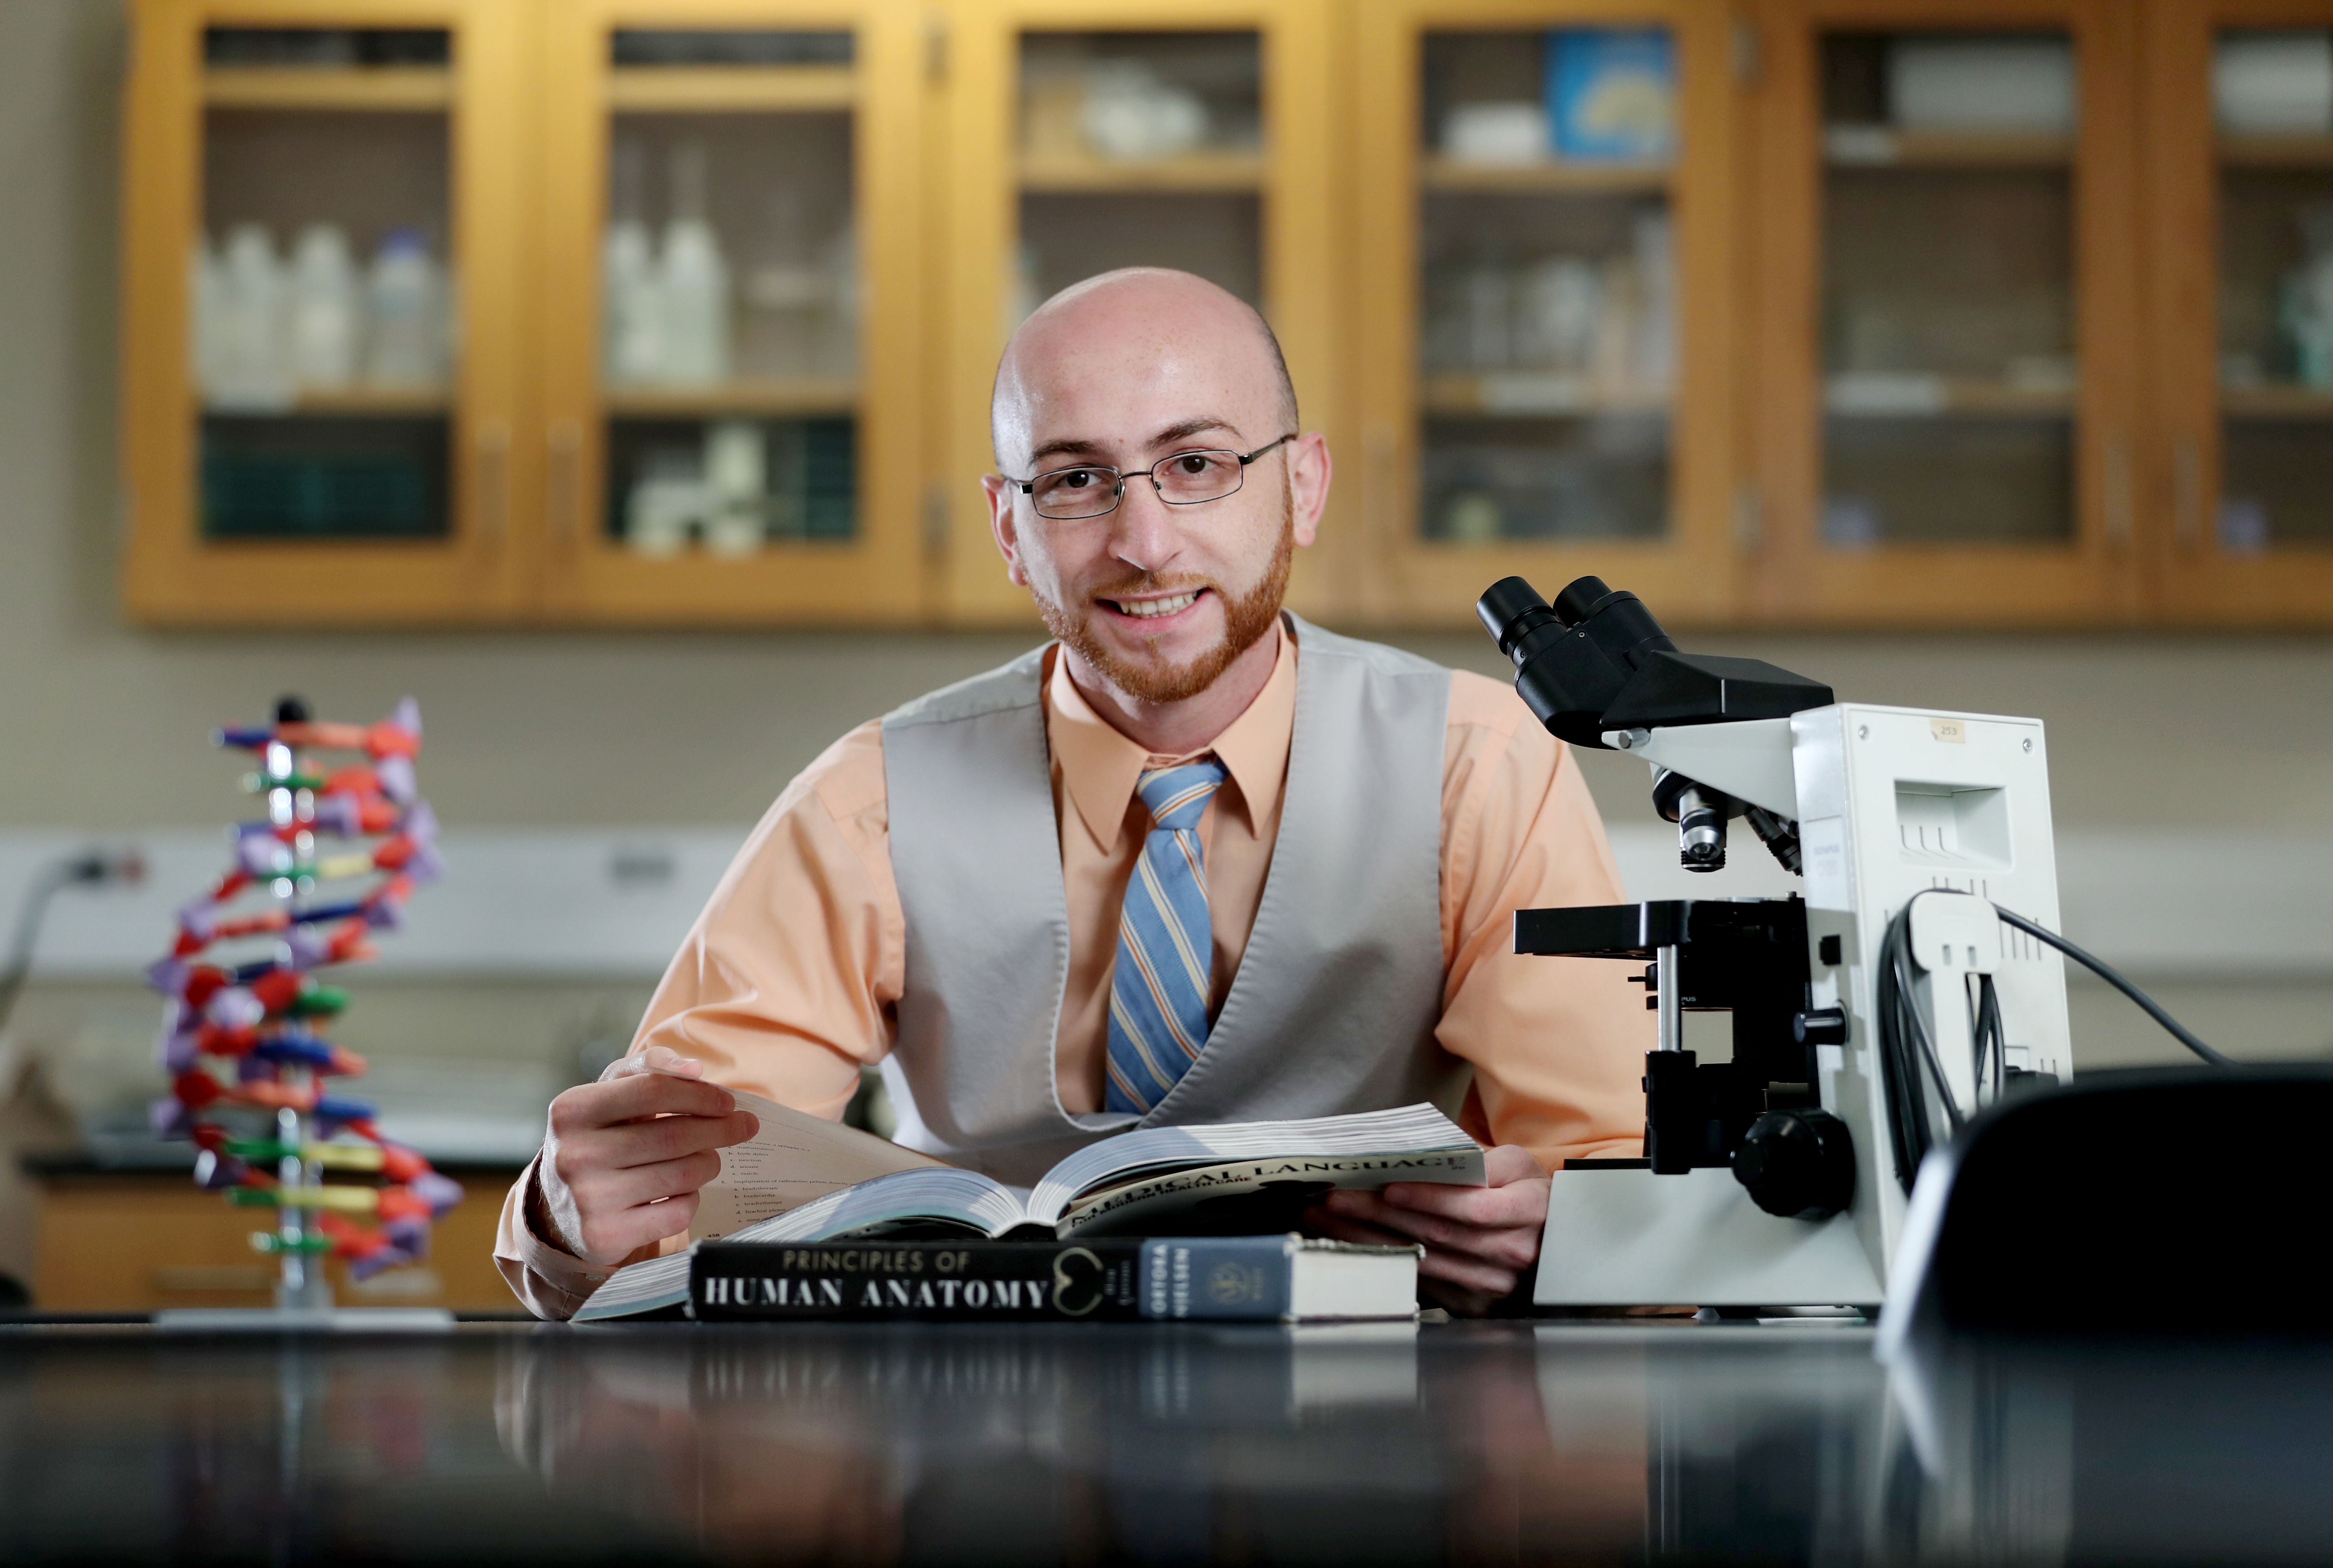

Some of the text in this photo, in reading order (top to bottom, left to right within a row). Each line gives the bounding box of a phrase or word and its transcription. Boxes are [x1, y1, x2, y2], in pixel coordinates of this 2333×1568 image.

[1941, 726, 1957, 735] 253
[1072, 1156, 1466, 1223] MEDICAL LANGUAGE
[1160, 1181, 1211, 1194] HEALTH
[1216, 1176, 1251, 1185] CARE
[783, 1250, 970, 1272] PRINCIPLES OF
[706, 1277, 1049, 1308] HUMAN ANATOMY
[1150, 1244, 1168, 1318] ORTORA
